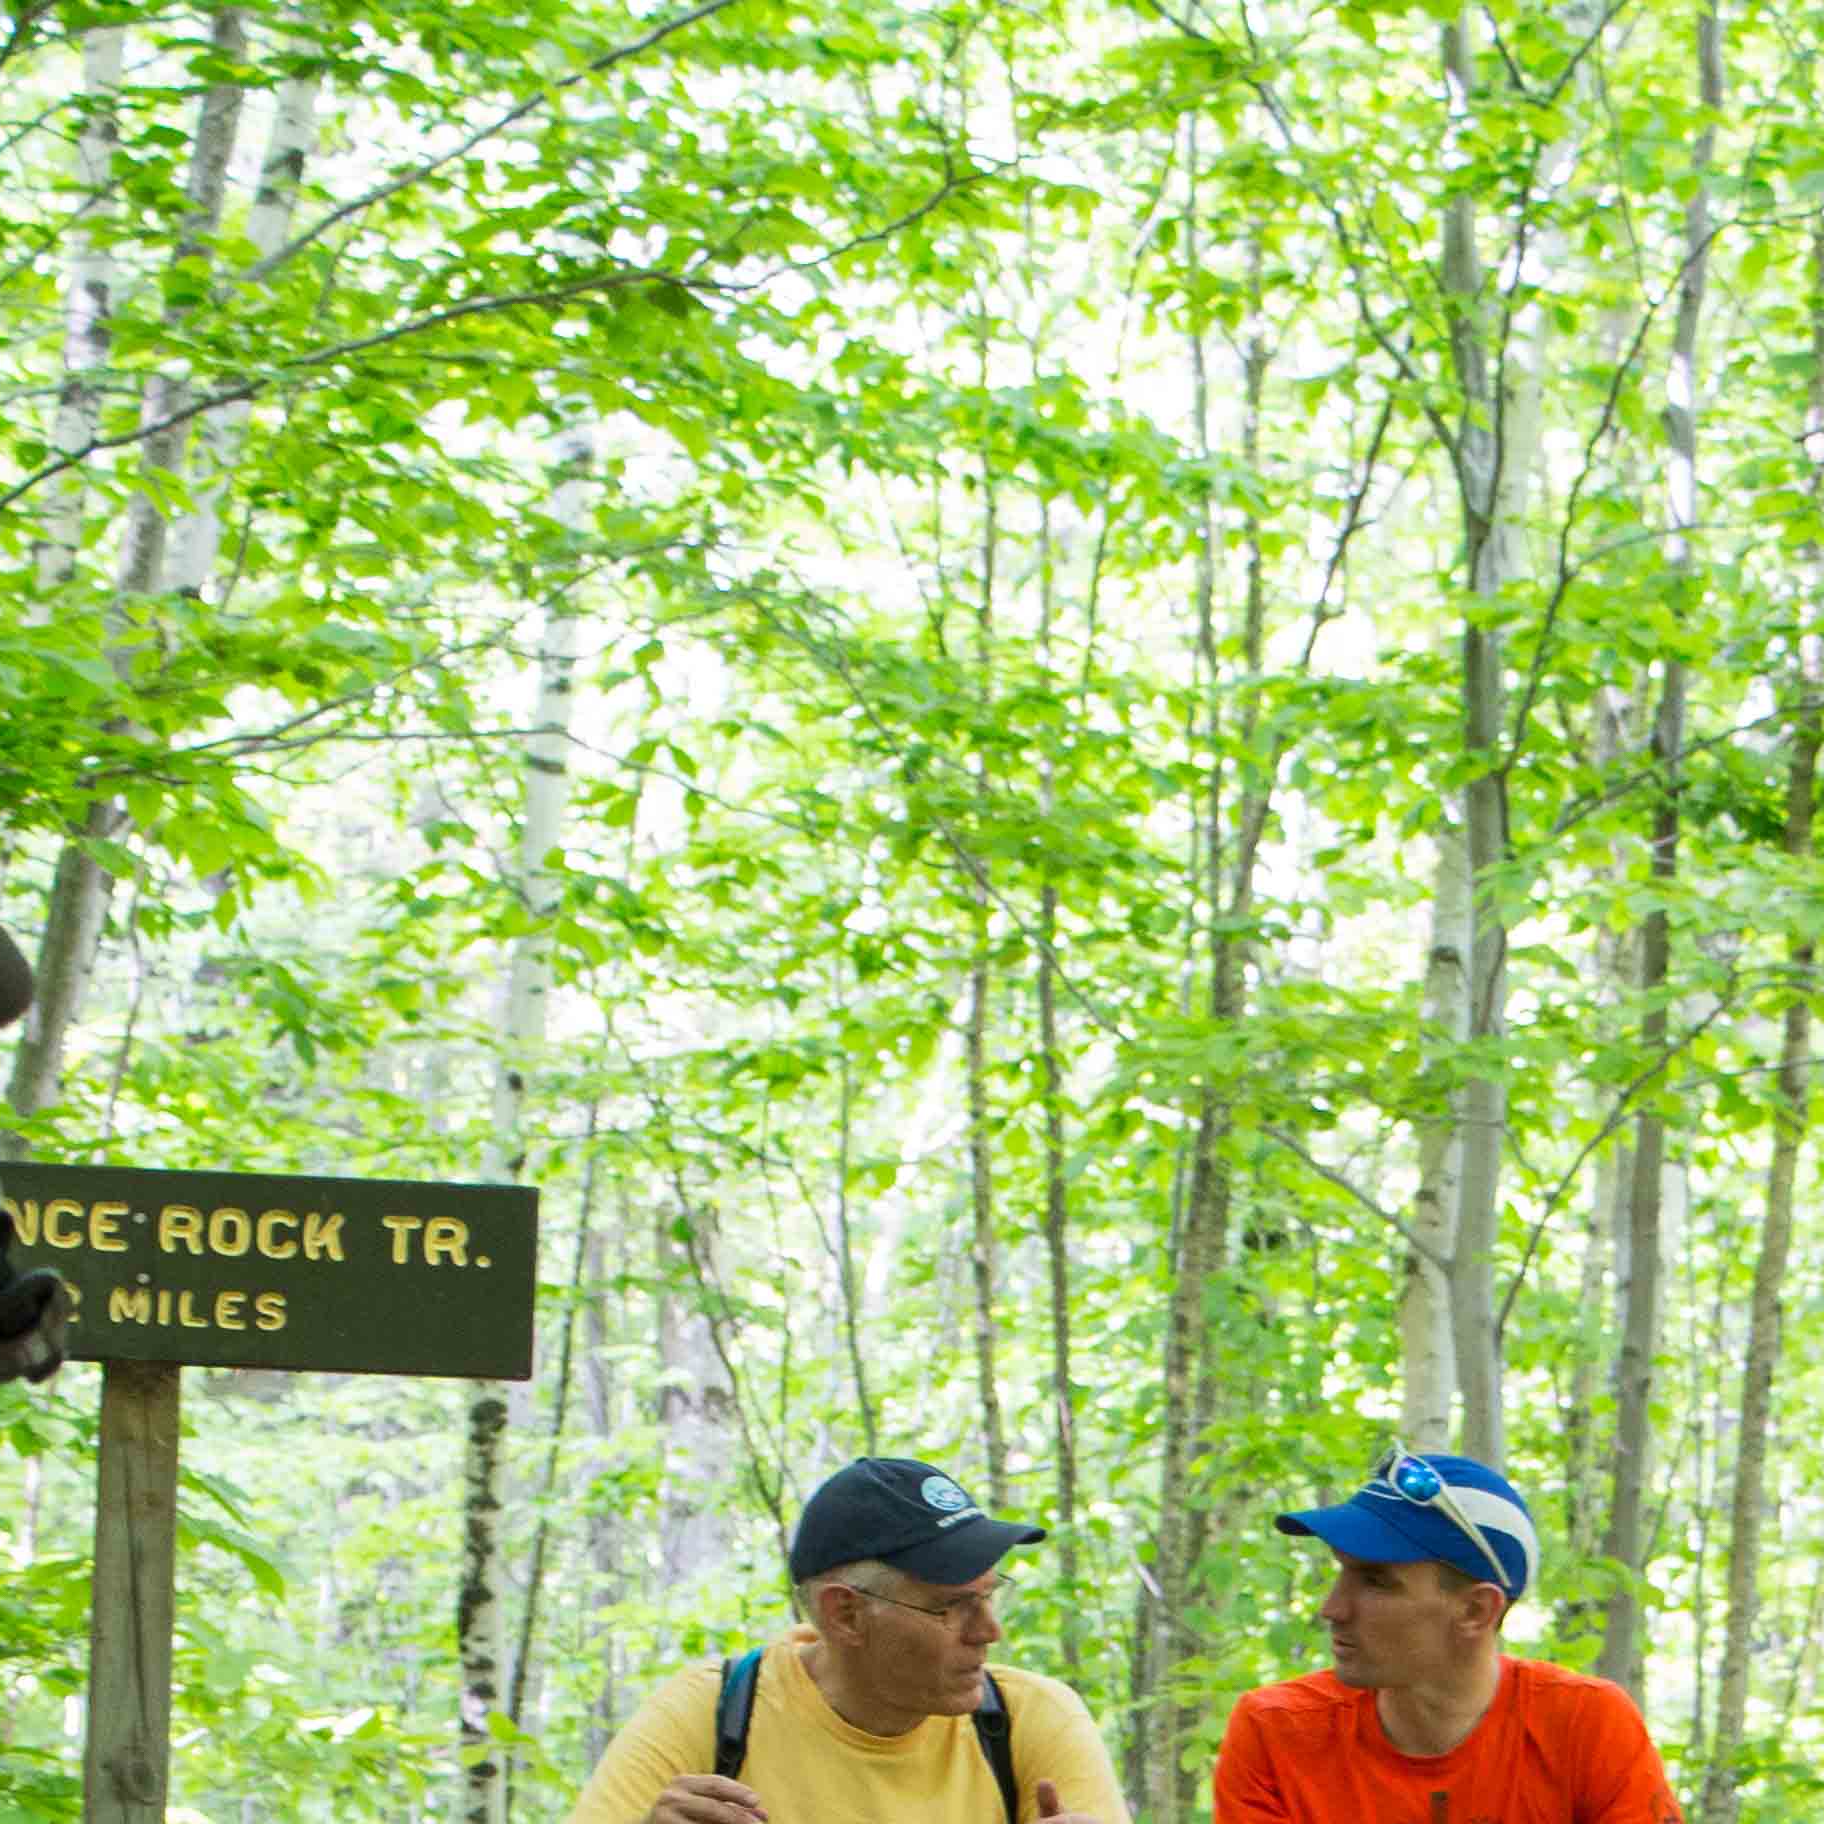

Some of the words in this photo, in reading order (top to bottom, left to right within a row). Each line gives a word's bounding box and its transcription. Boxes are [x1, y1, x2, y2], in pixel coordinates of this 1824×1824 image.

[158, 1203, 345, 1262] ROCK
[382, 1214, 492, 1268] TR.
[108, 1286, 288, 1331] MILES
